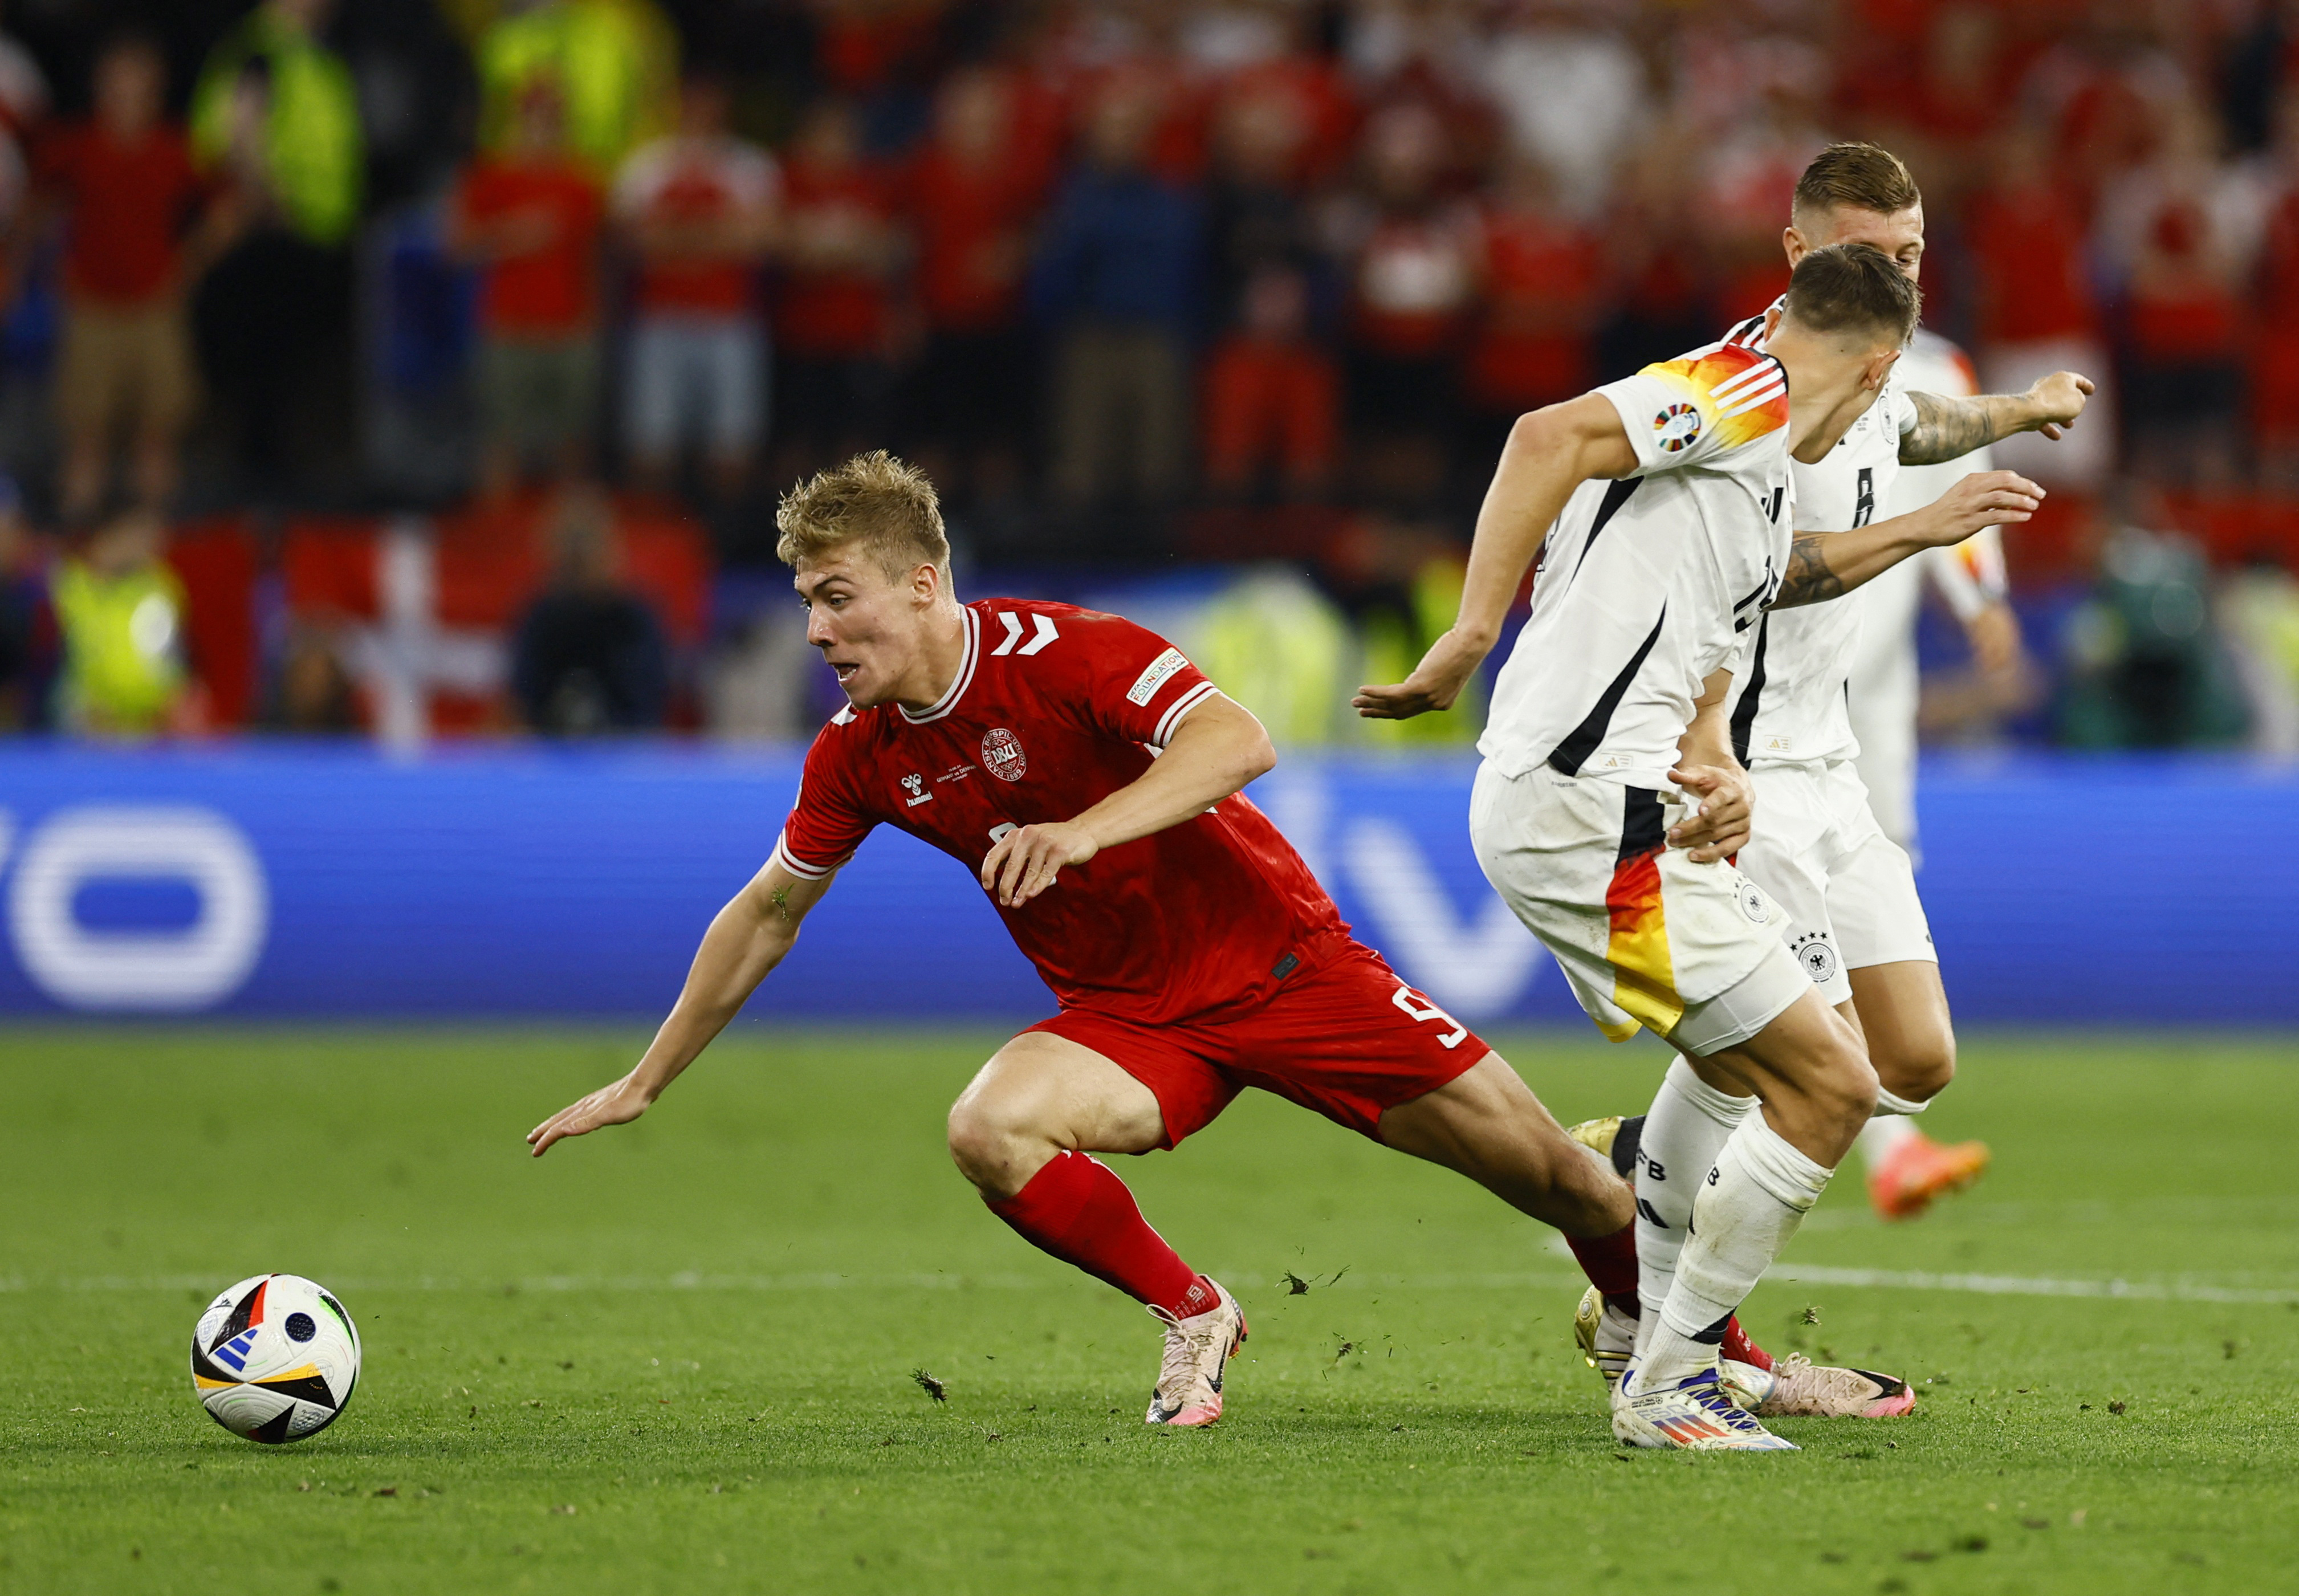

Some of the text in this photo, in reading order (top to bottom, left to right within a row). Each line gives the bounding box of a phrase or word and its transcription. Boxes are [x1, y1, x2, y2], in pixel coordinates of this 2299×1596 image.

[1129, 684, 1140, 698] UEFA
[1133, 653, 1182, 702] FOUNDATION
[991, 743, 1018, 764] DBU
[906, 791, 933, 807] hummel
[1392, 986, 1468, 1049] 9
[1638, 1147, 1666, 1181] FB
